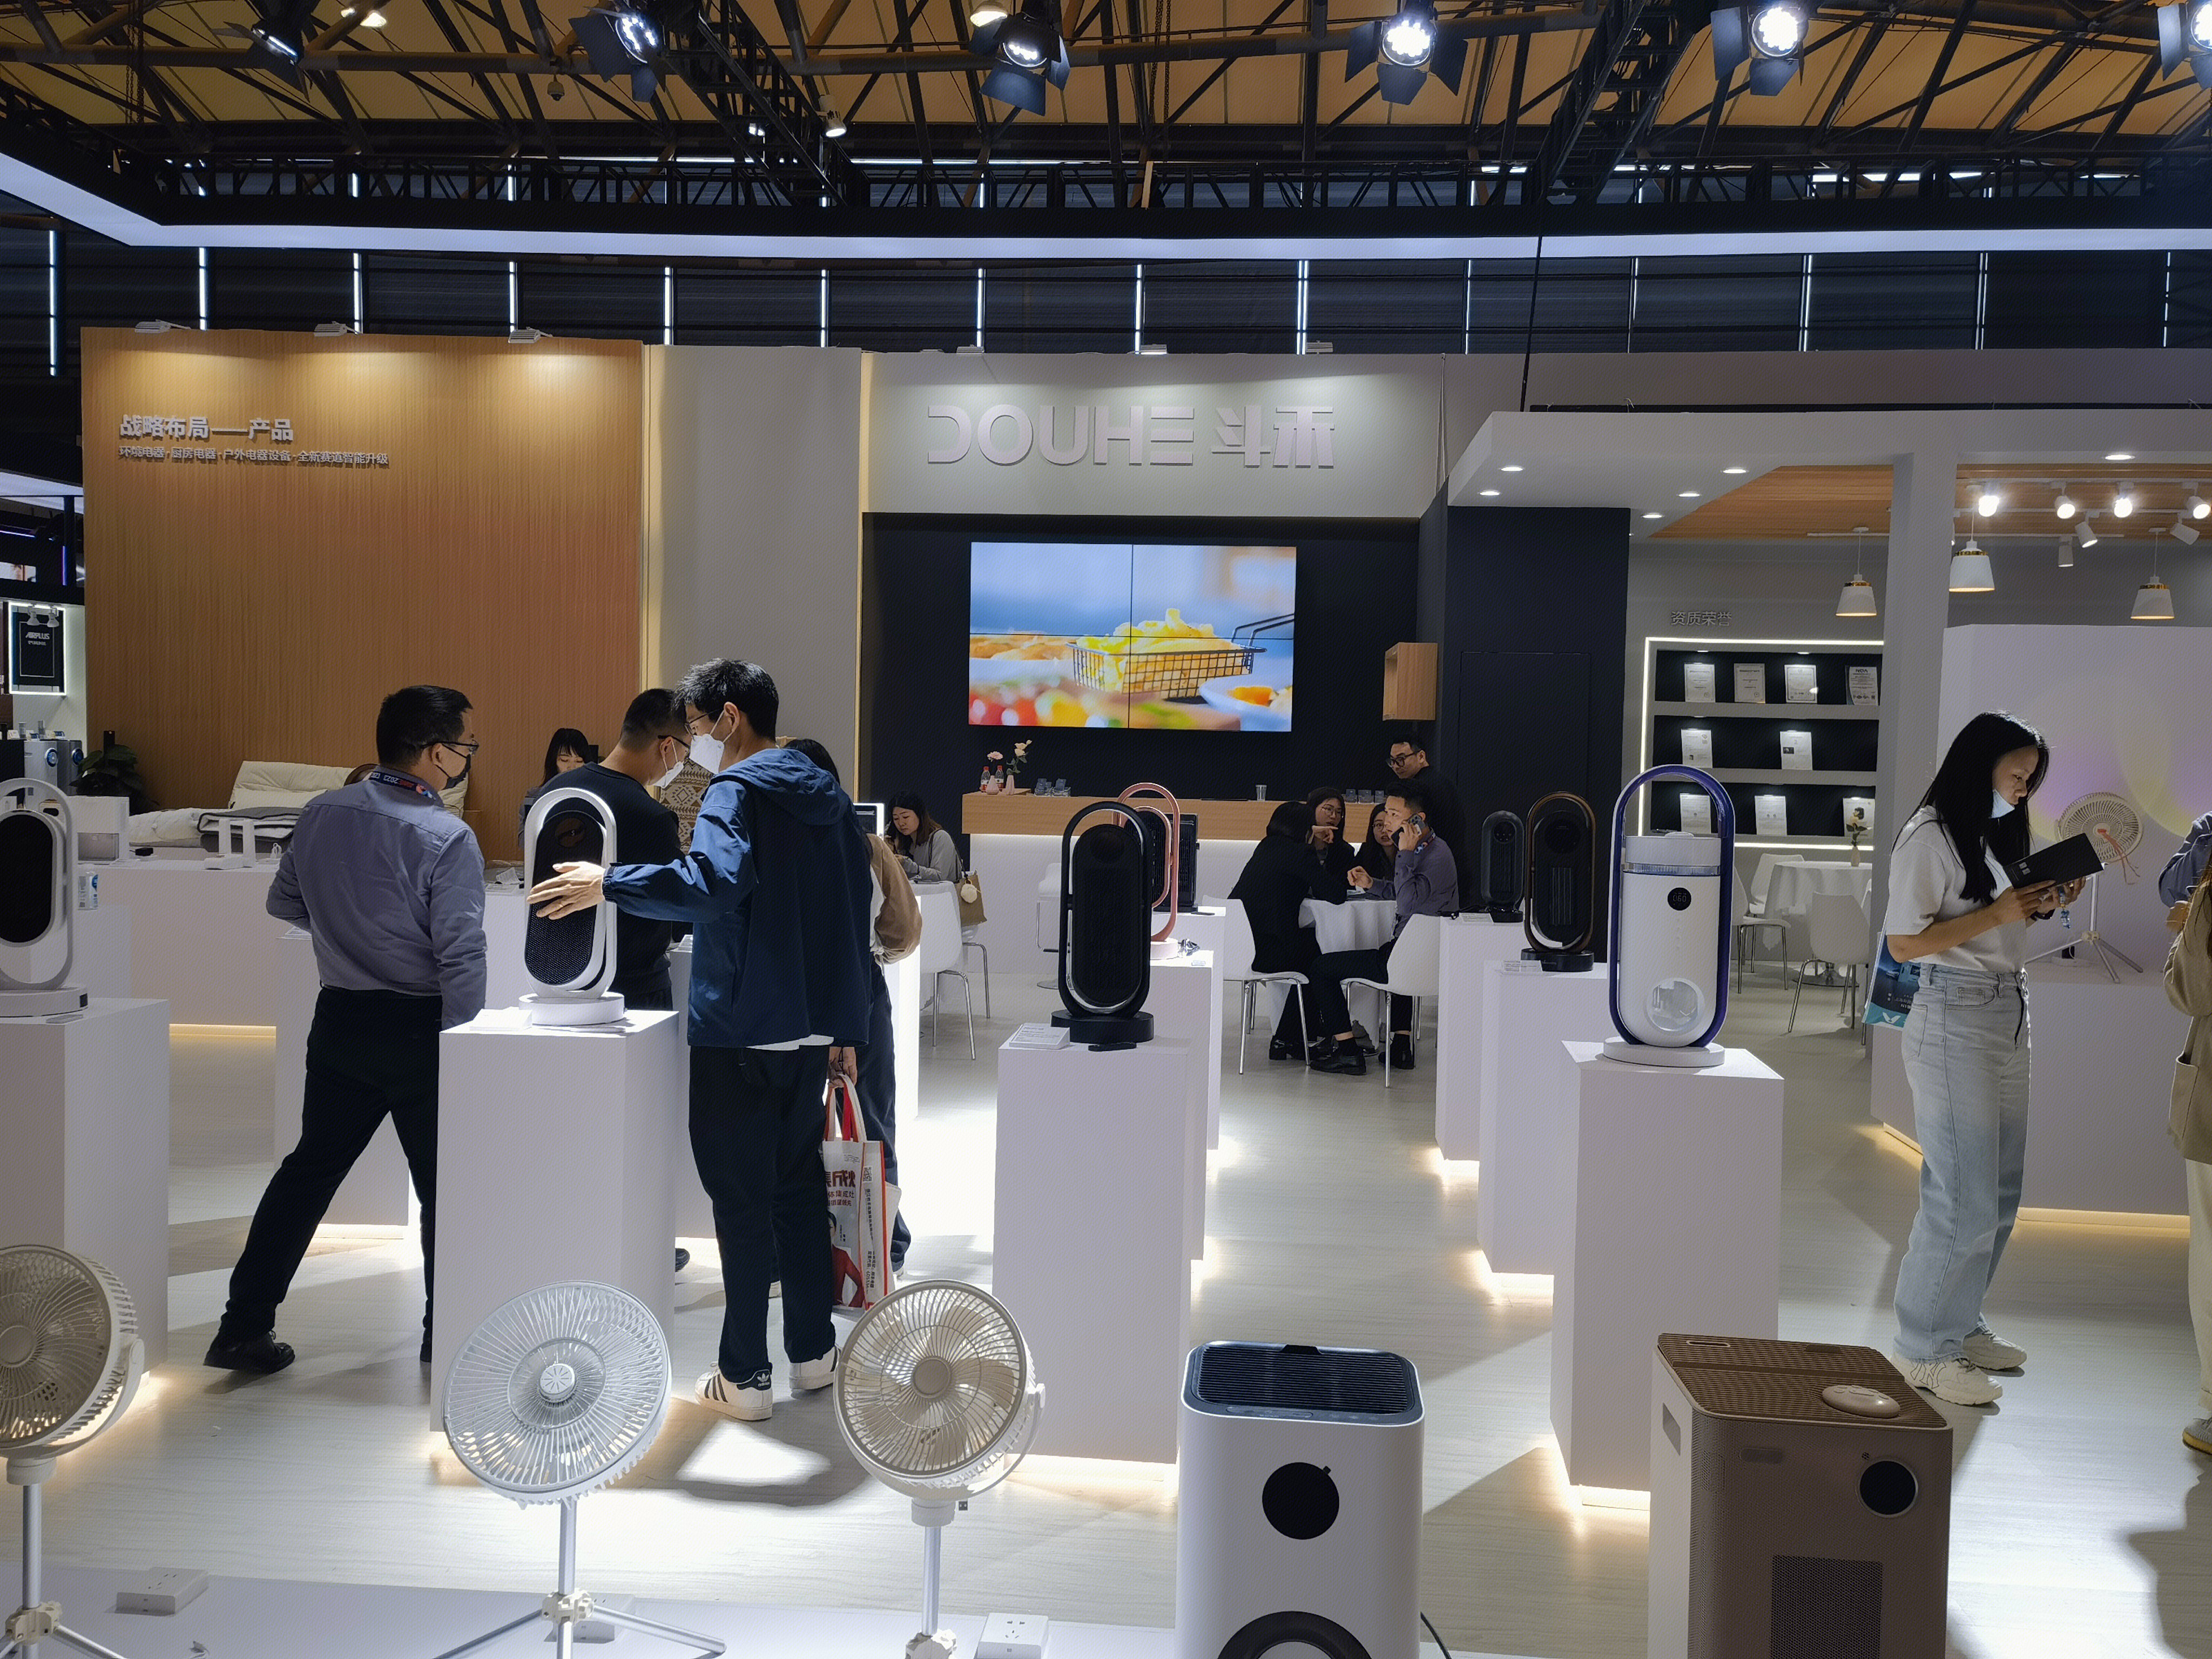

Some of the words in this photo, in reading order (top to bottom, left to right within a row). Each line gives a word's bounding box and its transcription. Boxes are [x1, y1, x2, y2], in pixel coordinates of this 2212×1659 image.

[928, 404, 1194, 466] DOUHE
[1211, 404, 1335, 468] 斗禾
[1671, 611, 1732, 626] 资质荣誉
